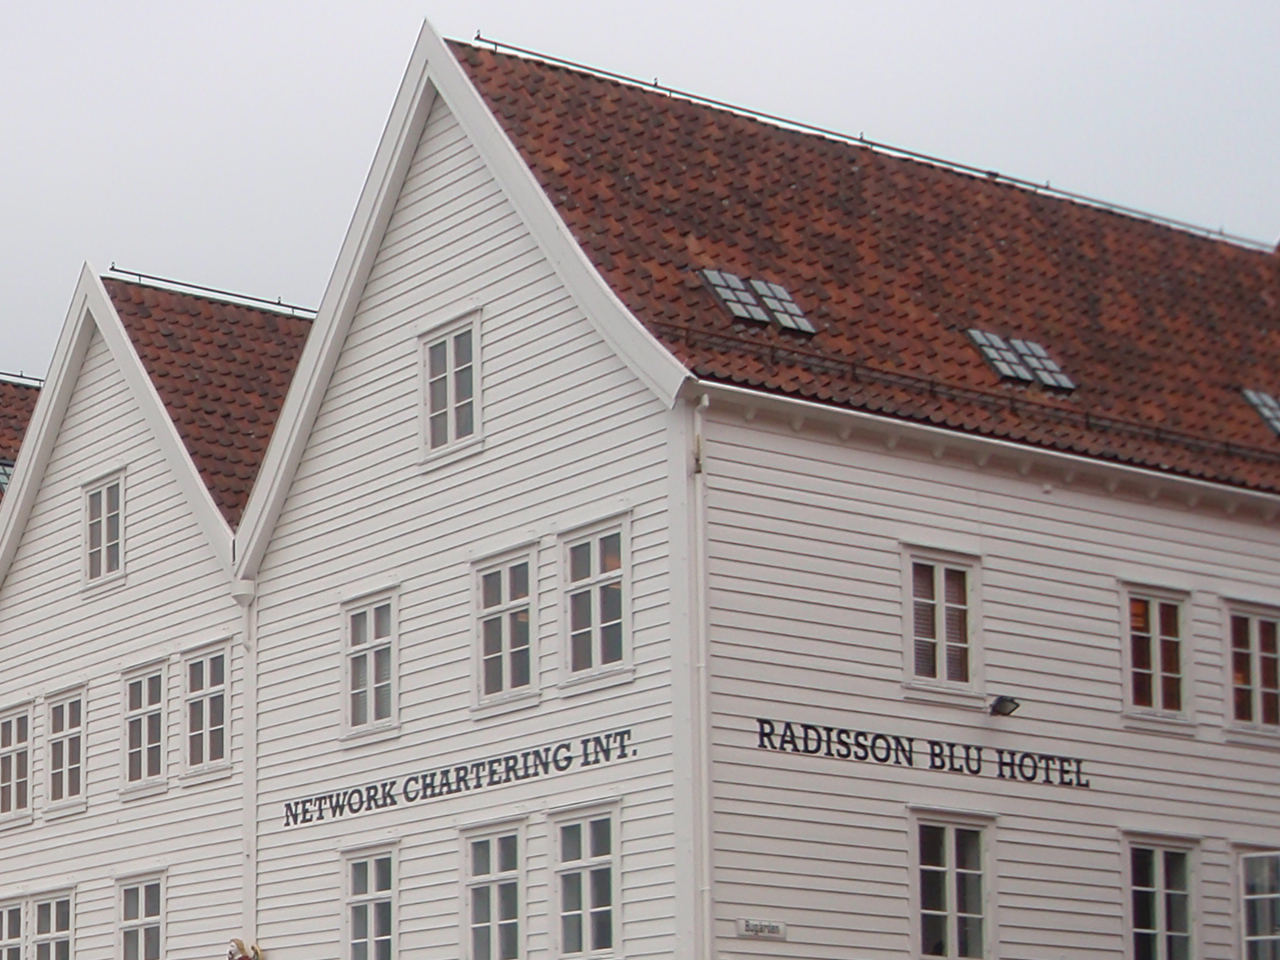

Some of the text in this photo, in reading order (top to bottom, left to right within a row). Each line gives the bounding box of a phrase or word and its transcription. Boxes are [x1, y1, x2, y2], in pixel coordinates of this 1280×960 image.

[283, 729, 638, 827] NETWORK CHARTERING INT.
[756, 718, 1091, 788] RADISSON BLU HOTEL
